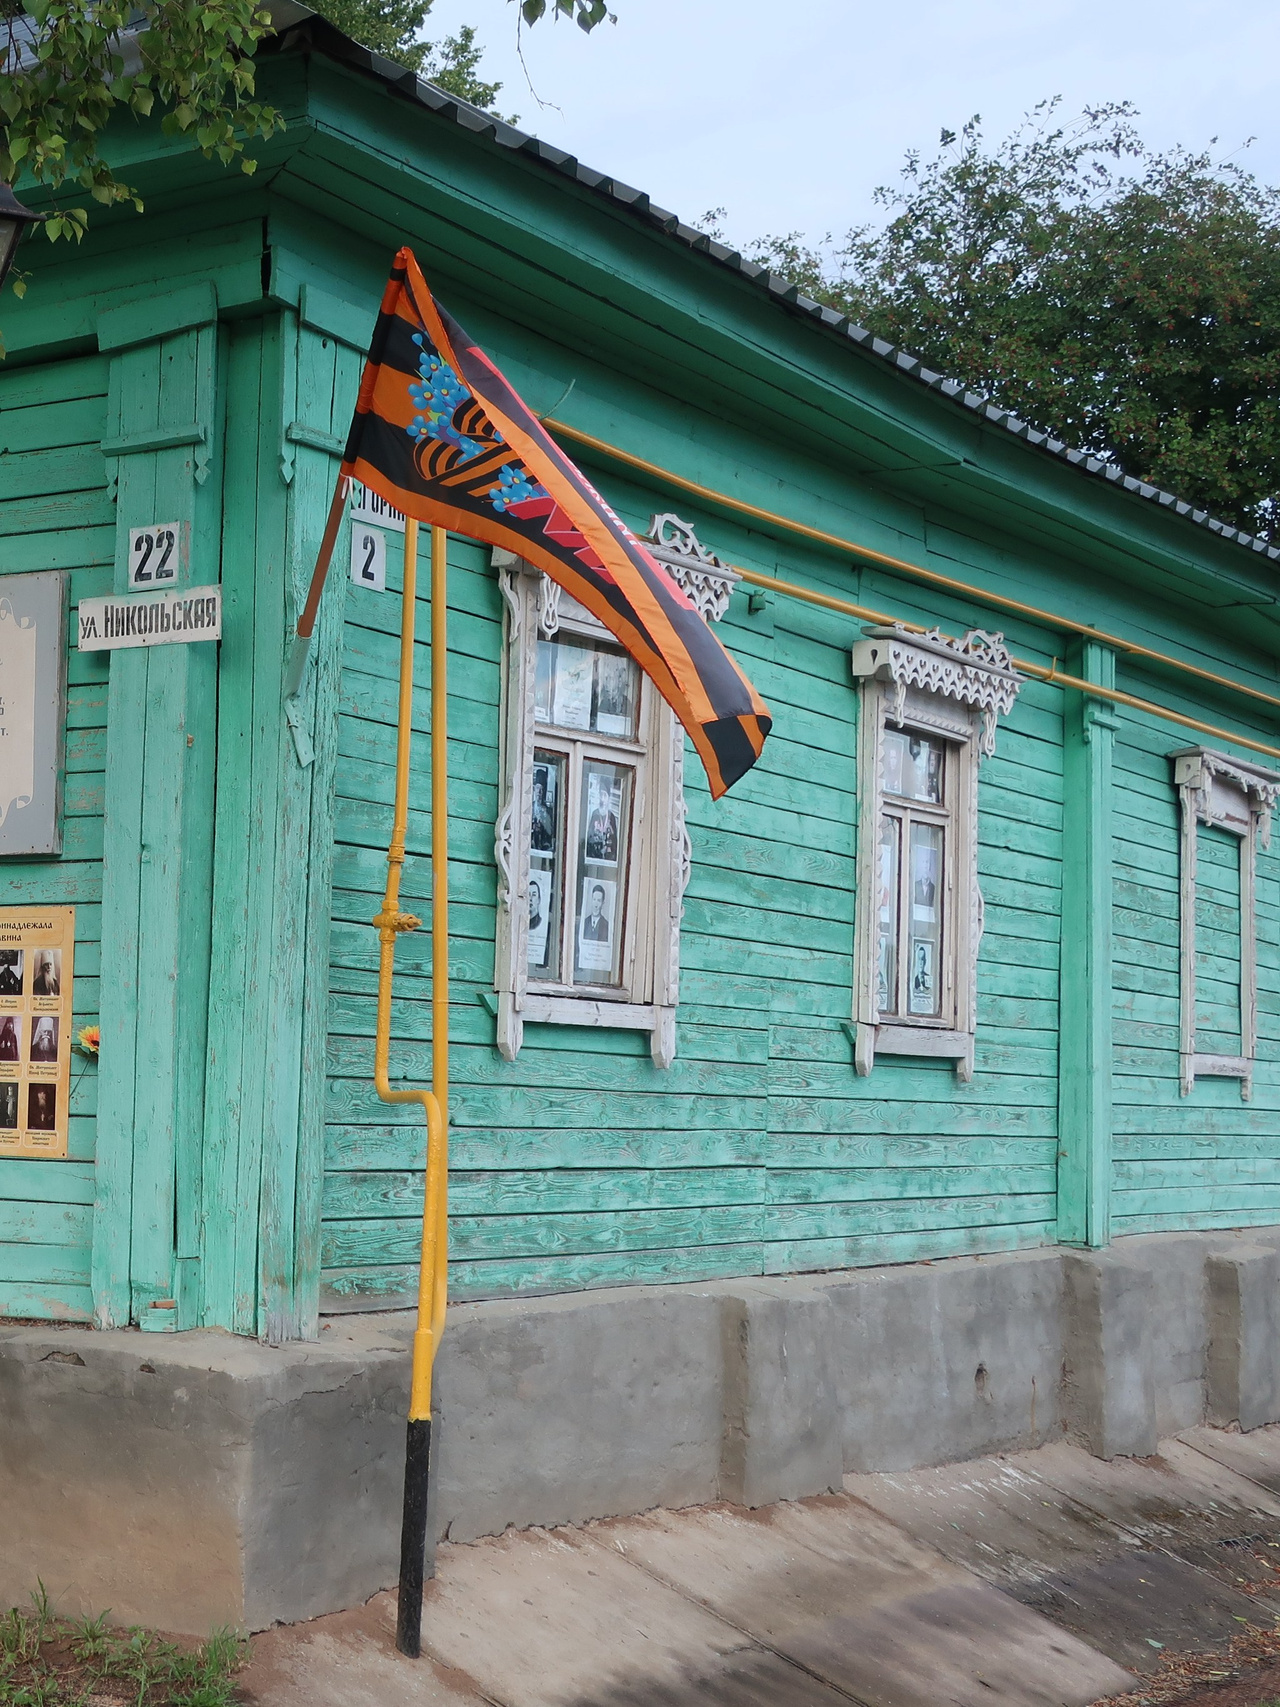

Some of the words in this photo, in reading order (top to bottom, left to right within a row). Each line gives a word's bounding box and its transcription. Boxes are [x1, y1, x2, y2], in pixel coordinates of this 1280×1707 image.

[134, 530, 175, 582] 22
[362, 535, 376, 581] 2
[104, 597, 216, 638] НИКОЛЬСКАЯ
